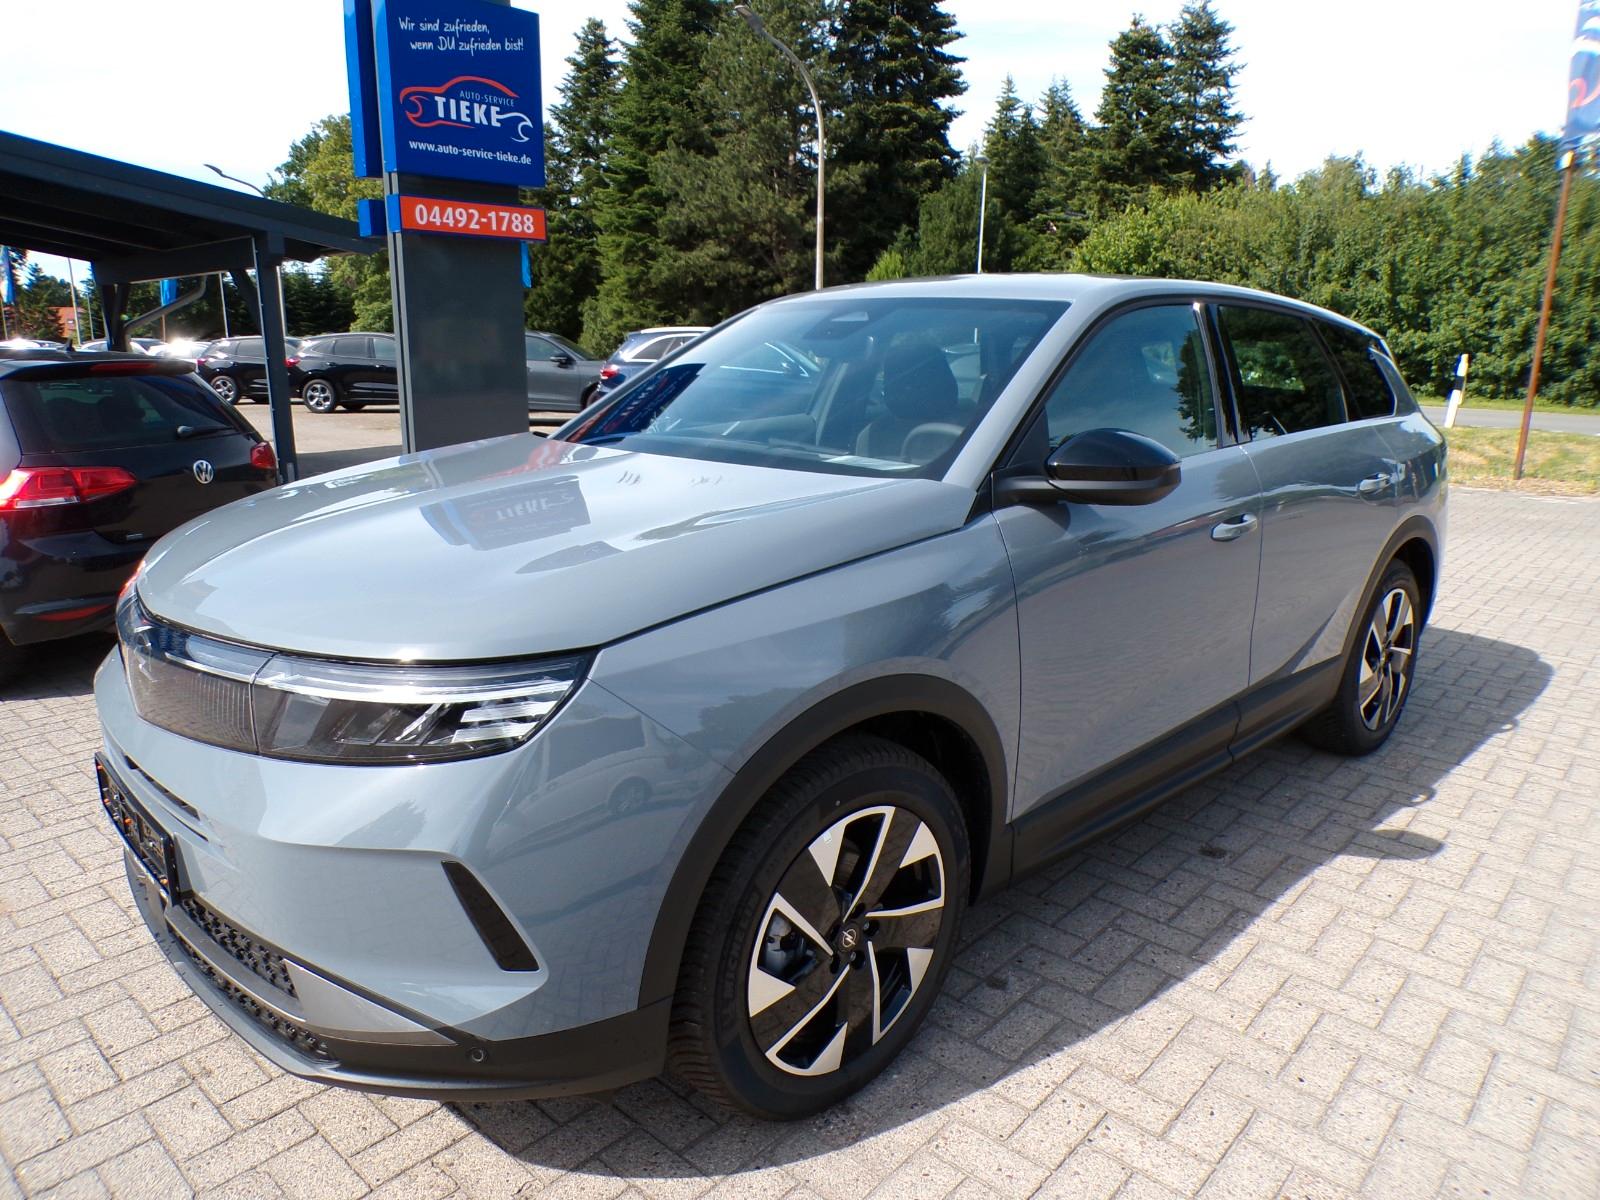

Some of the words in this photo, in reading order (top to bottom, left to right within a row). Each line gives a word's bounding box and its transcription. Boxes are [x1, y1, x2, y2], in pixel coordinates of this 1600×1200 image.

[399, 17, 415, 31] Wir
[419, 19, 440, 32] sind
[442, 19, 490, 37] zufrieden,
[410, 40, 434, 50] wenn
[437, 36, 456, 51] DU
[459, 38, 502, 56] zufrieden
[504, 37, 524, 51] bist!
[459, 90, 514, 107] AUTO-SERVICE
[434, 96, 502, 127] TIEKE
[408, 140, 532, 165] www.auto-service-tieke.de
[414, 203, 535, 233] 04492-1788
